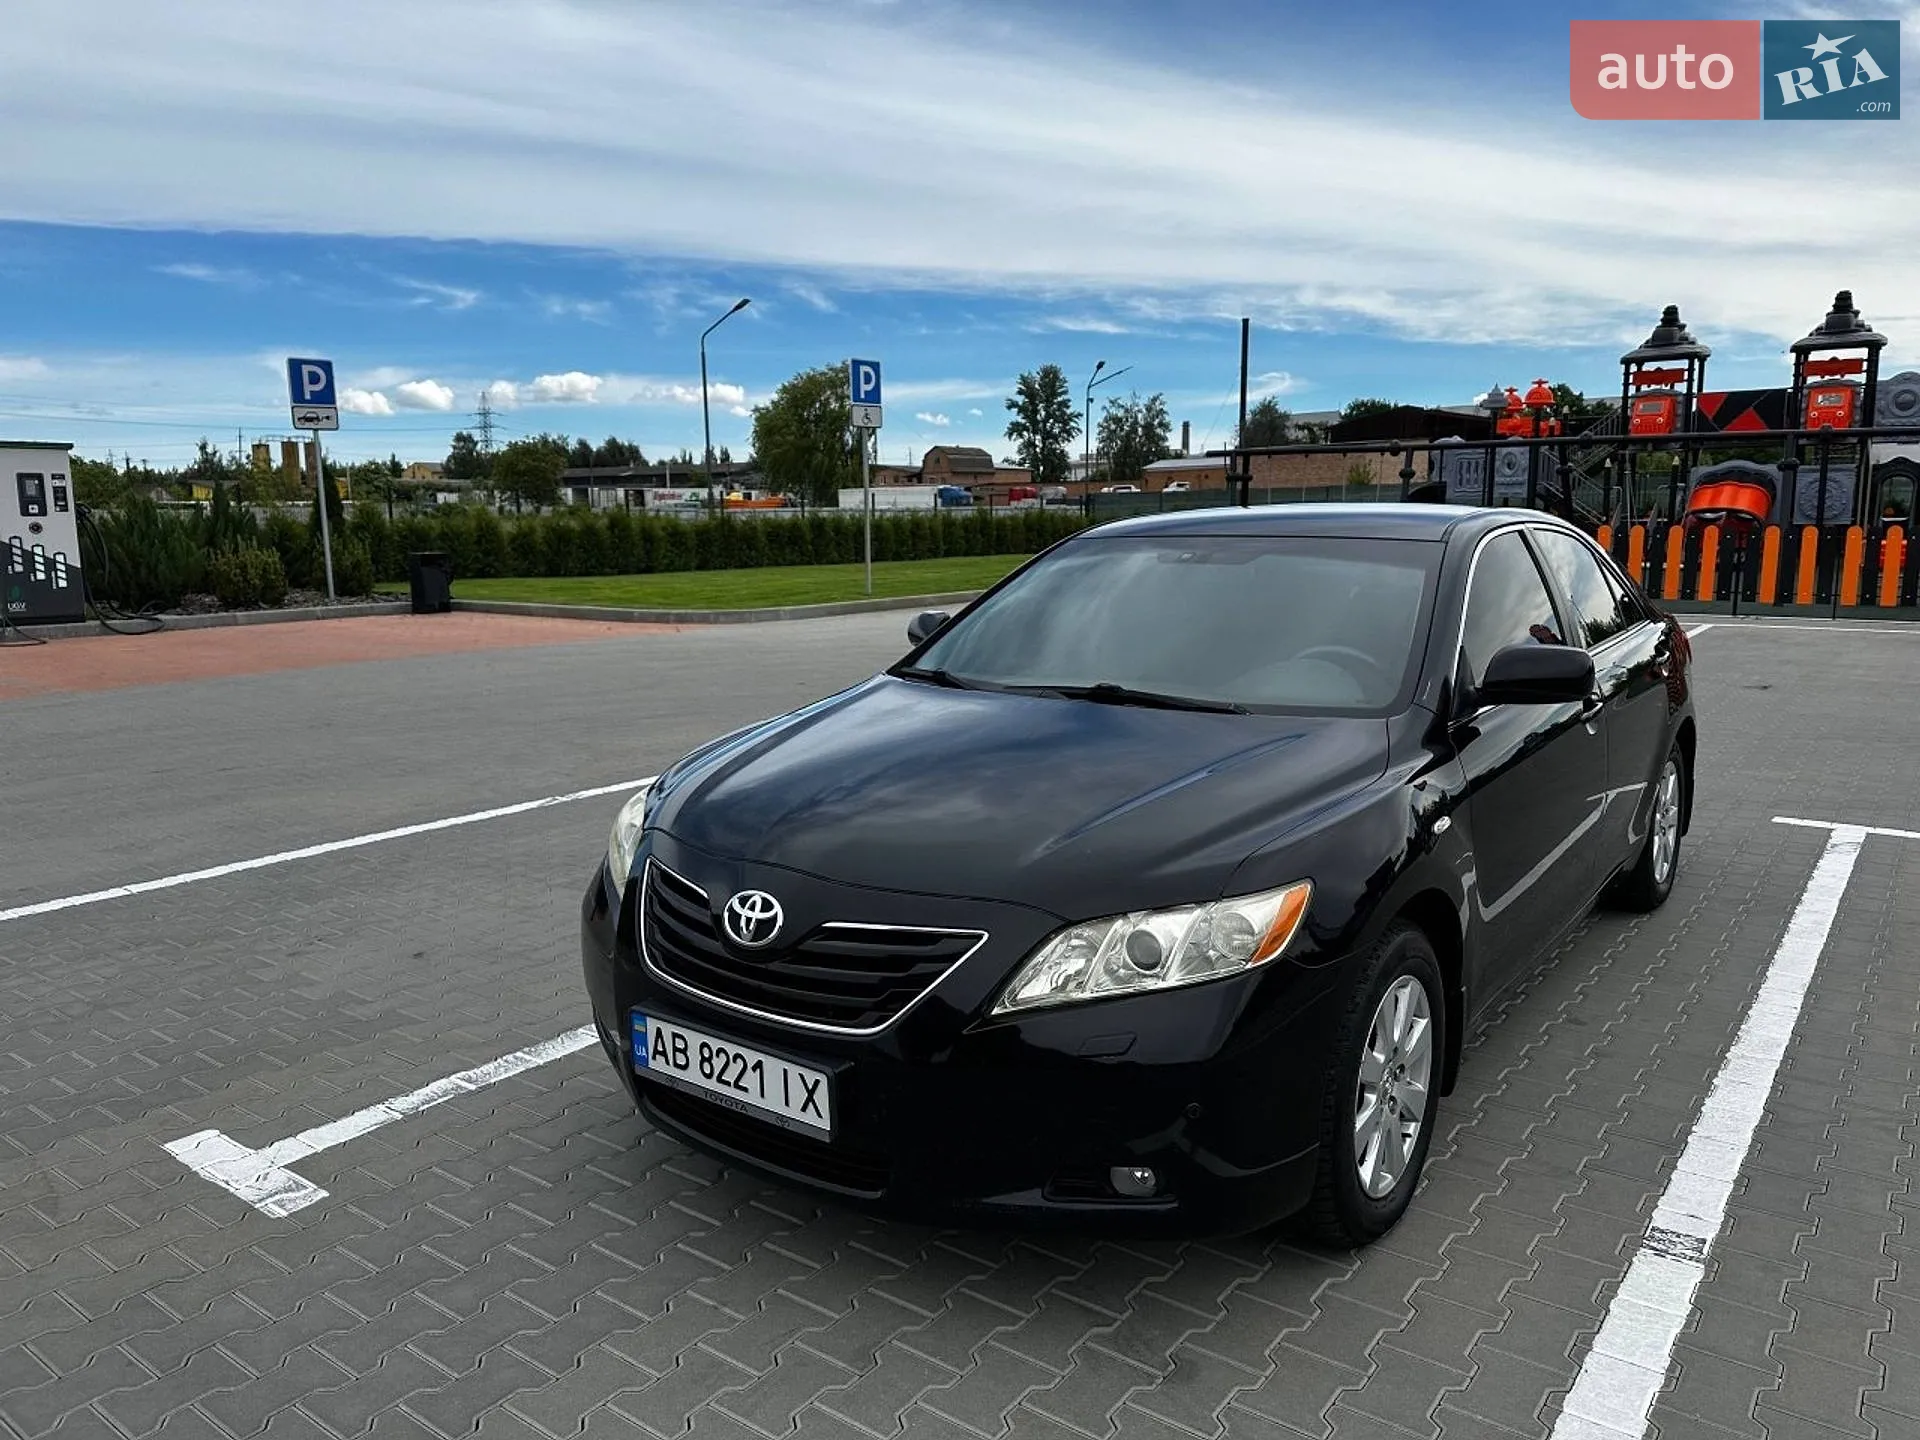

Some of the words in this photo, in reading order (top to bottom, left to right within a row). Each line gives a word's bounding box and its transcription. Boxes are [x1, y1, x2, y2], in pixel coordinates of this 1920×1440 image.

[301, 364, 327, 400] P
[860, 364, 876, 399] P
[634, 1044, 648, 1057] UA
[651, 1026, 690, 1071] AB
[699, 1041, 765, 1099] 8221
[782, 1067, 824, 1119] IX
[704, 1090, 748, 1113] TOYOTA
